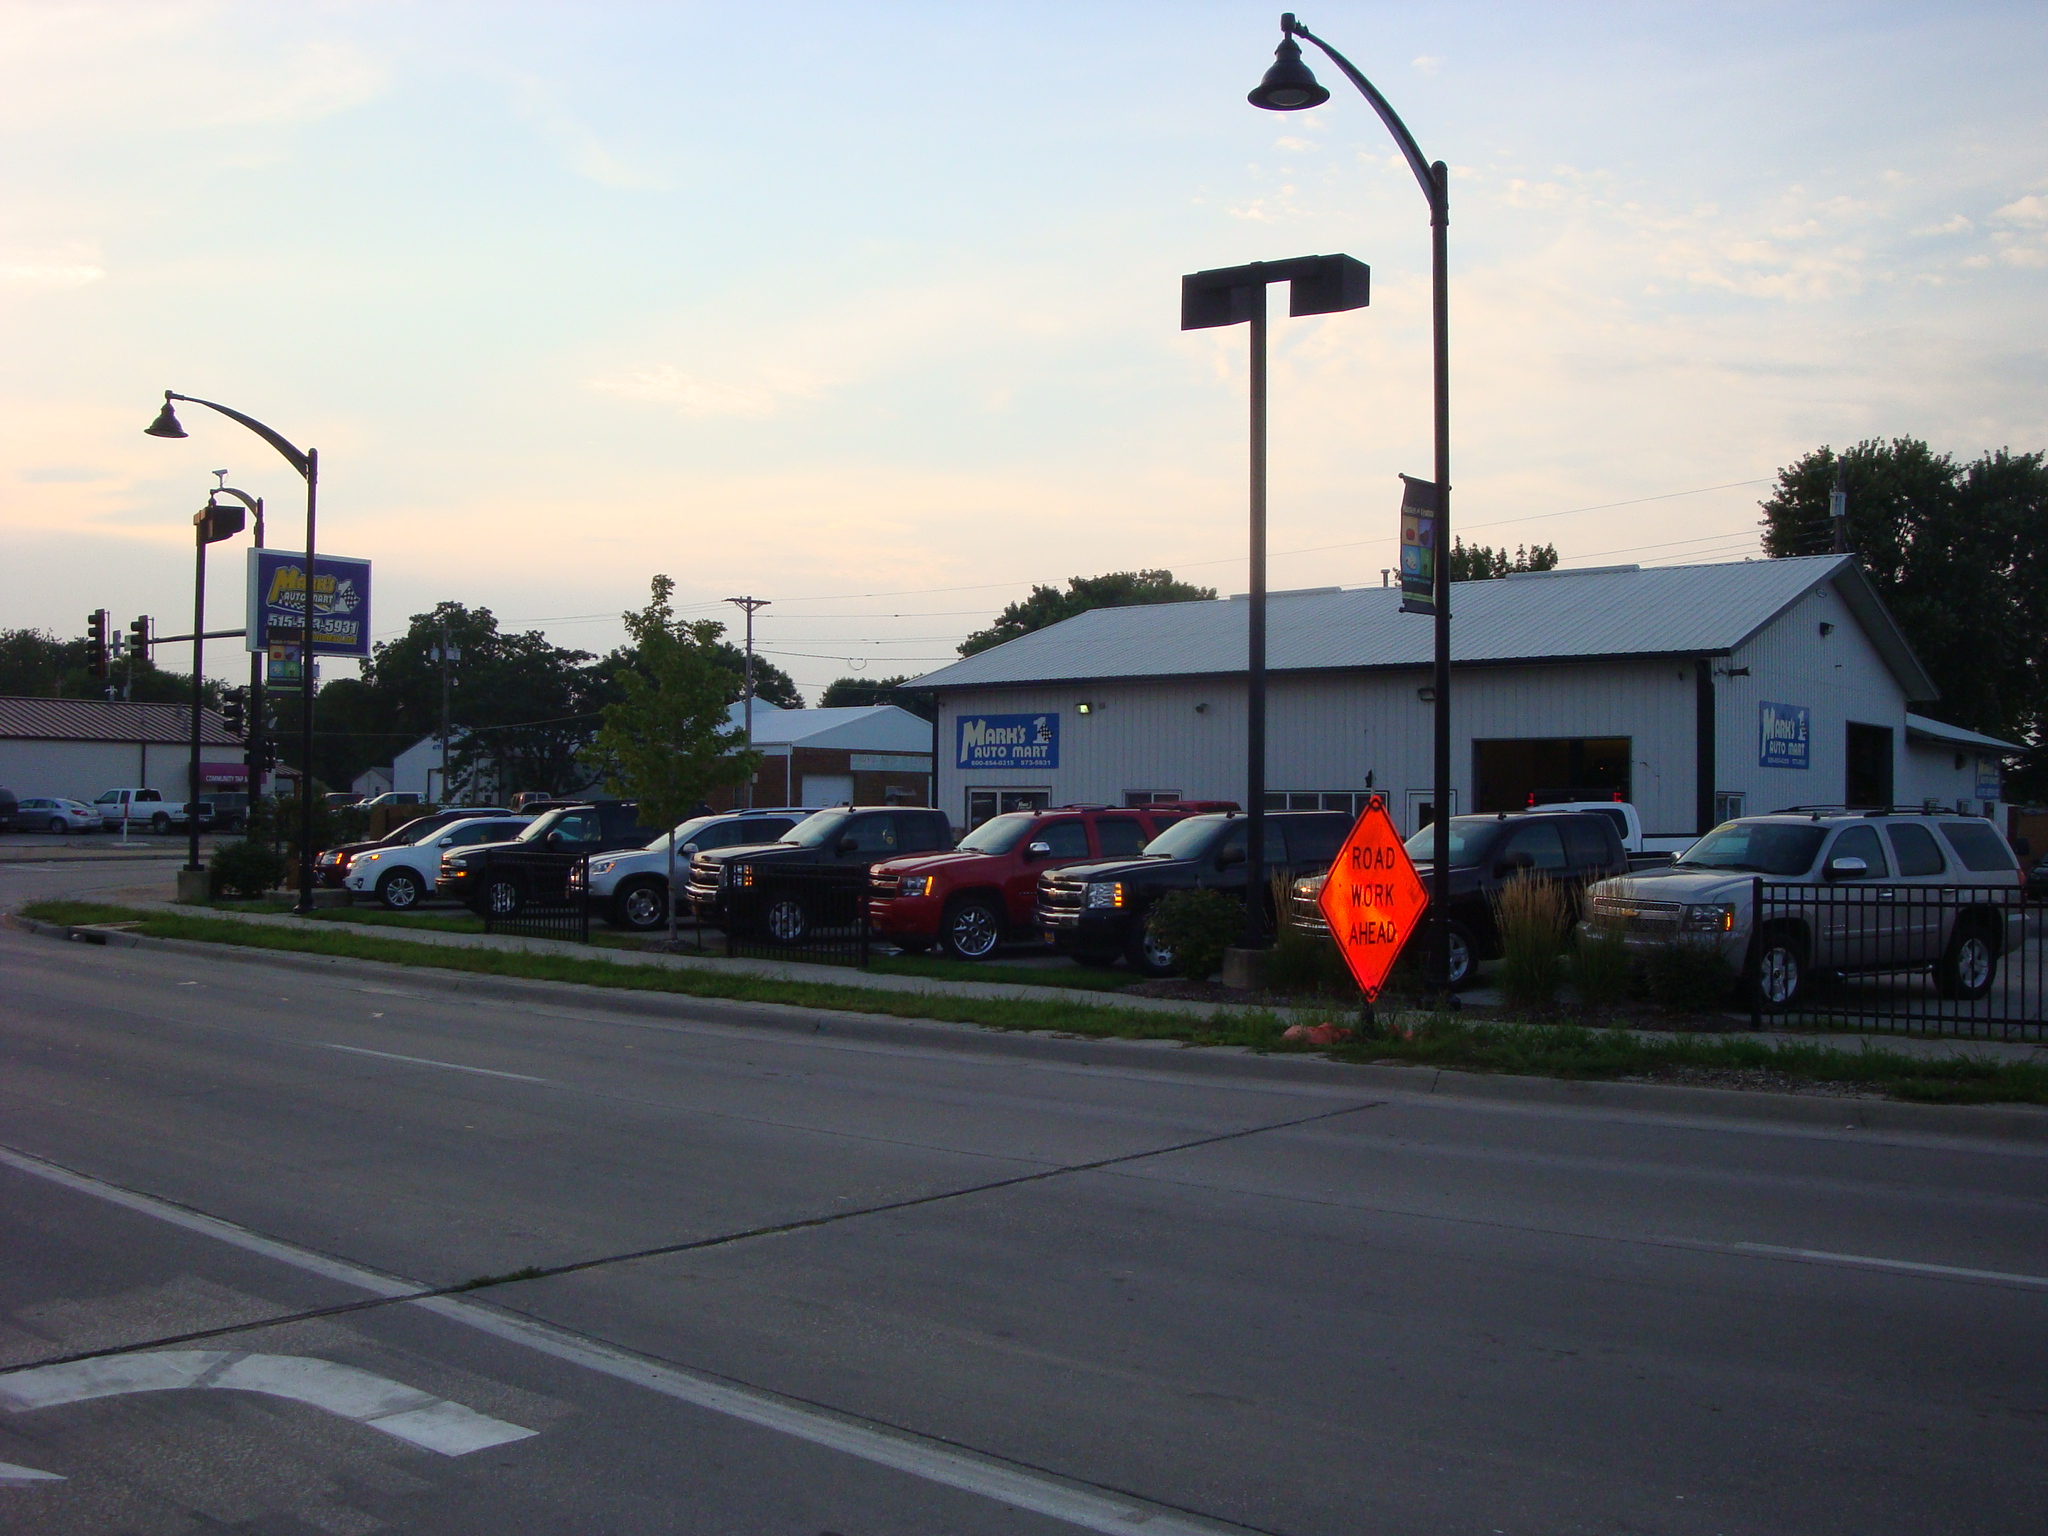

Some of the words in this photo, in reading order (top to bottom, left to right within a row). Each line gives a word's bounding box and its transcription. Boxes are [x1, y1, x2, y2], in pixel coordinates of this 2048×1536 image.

[284, 591, 306, 602] AUTO
[268, 614, 359, 634] 515-53-5931
[974, 746, 1007, 758] AUTO
[1012, 746, 1048, 758] MART
[1769, 740, 1786, 754] AUTO
[1788, 742, 1805, 756] MART
[1352, 847, 1395, 869] ROAD
[1351, 884, 1394, 907] WORK
[1349, 922, 1397, 945] AHEAD
